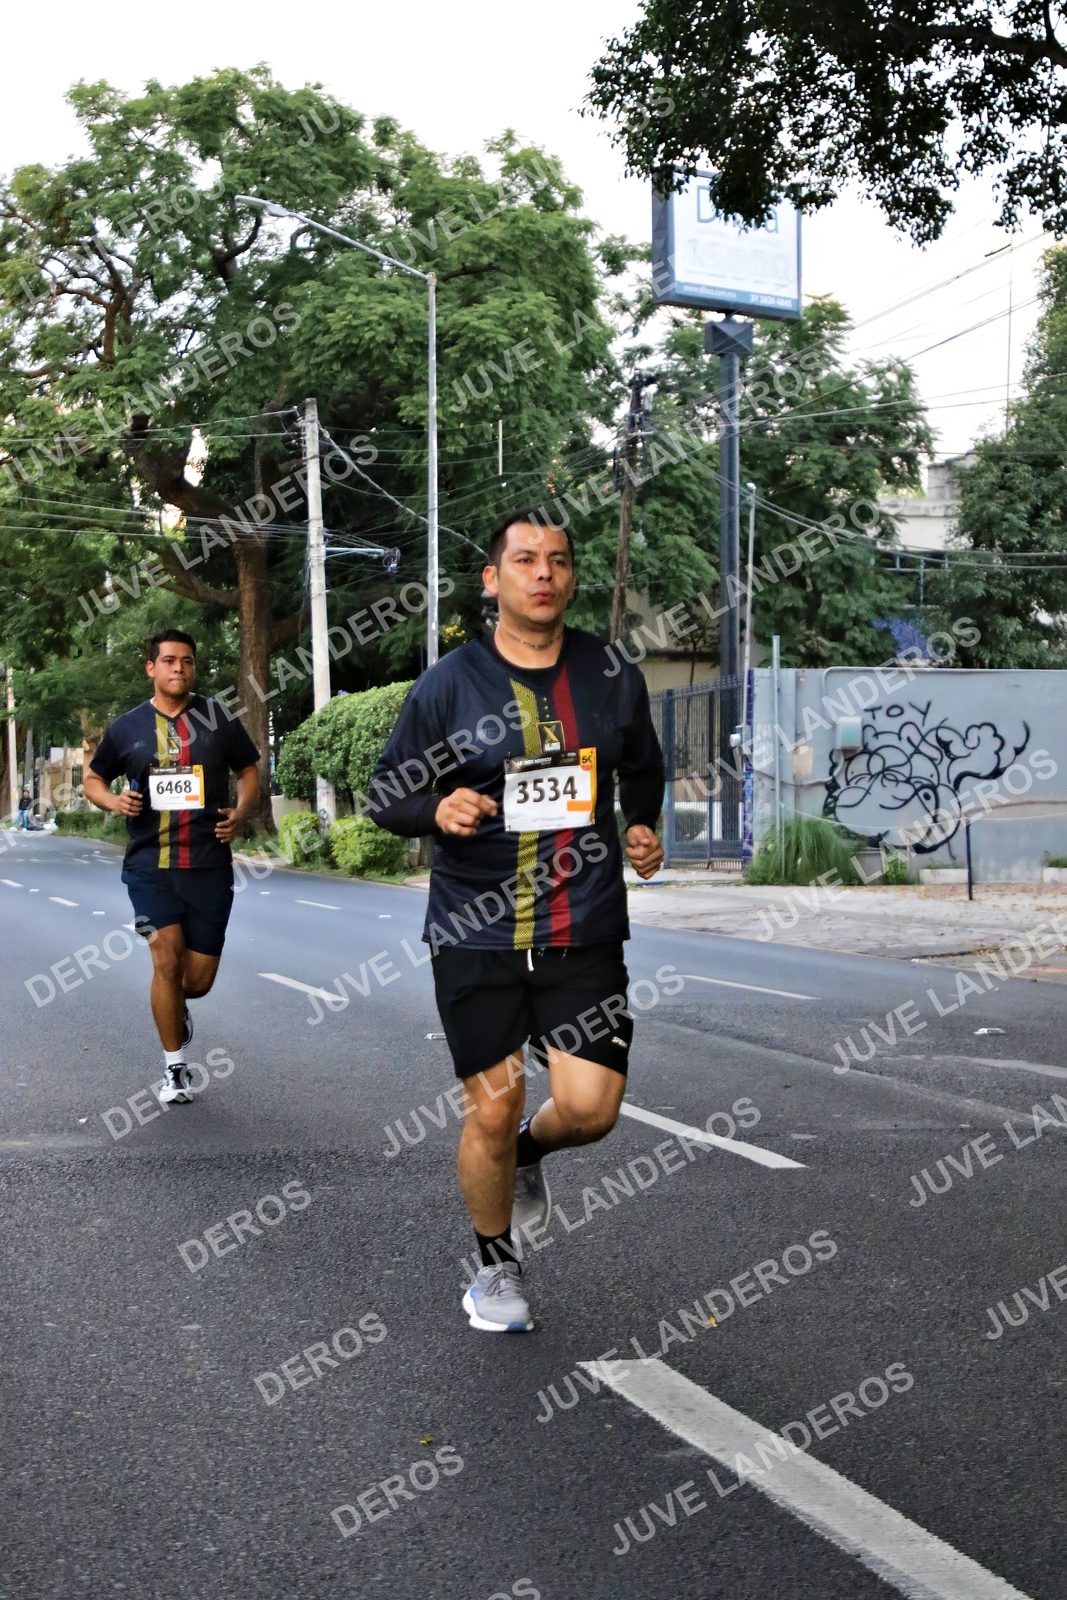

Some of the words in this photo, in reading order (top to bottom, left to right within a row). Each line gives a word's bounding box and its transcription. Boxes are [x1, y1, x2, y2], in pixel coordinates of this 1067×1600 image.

[863, 700, 932, 726] TOY
[156, 780, 192, 795] 6468
[516, 776, 578, 804] 3534
